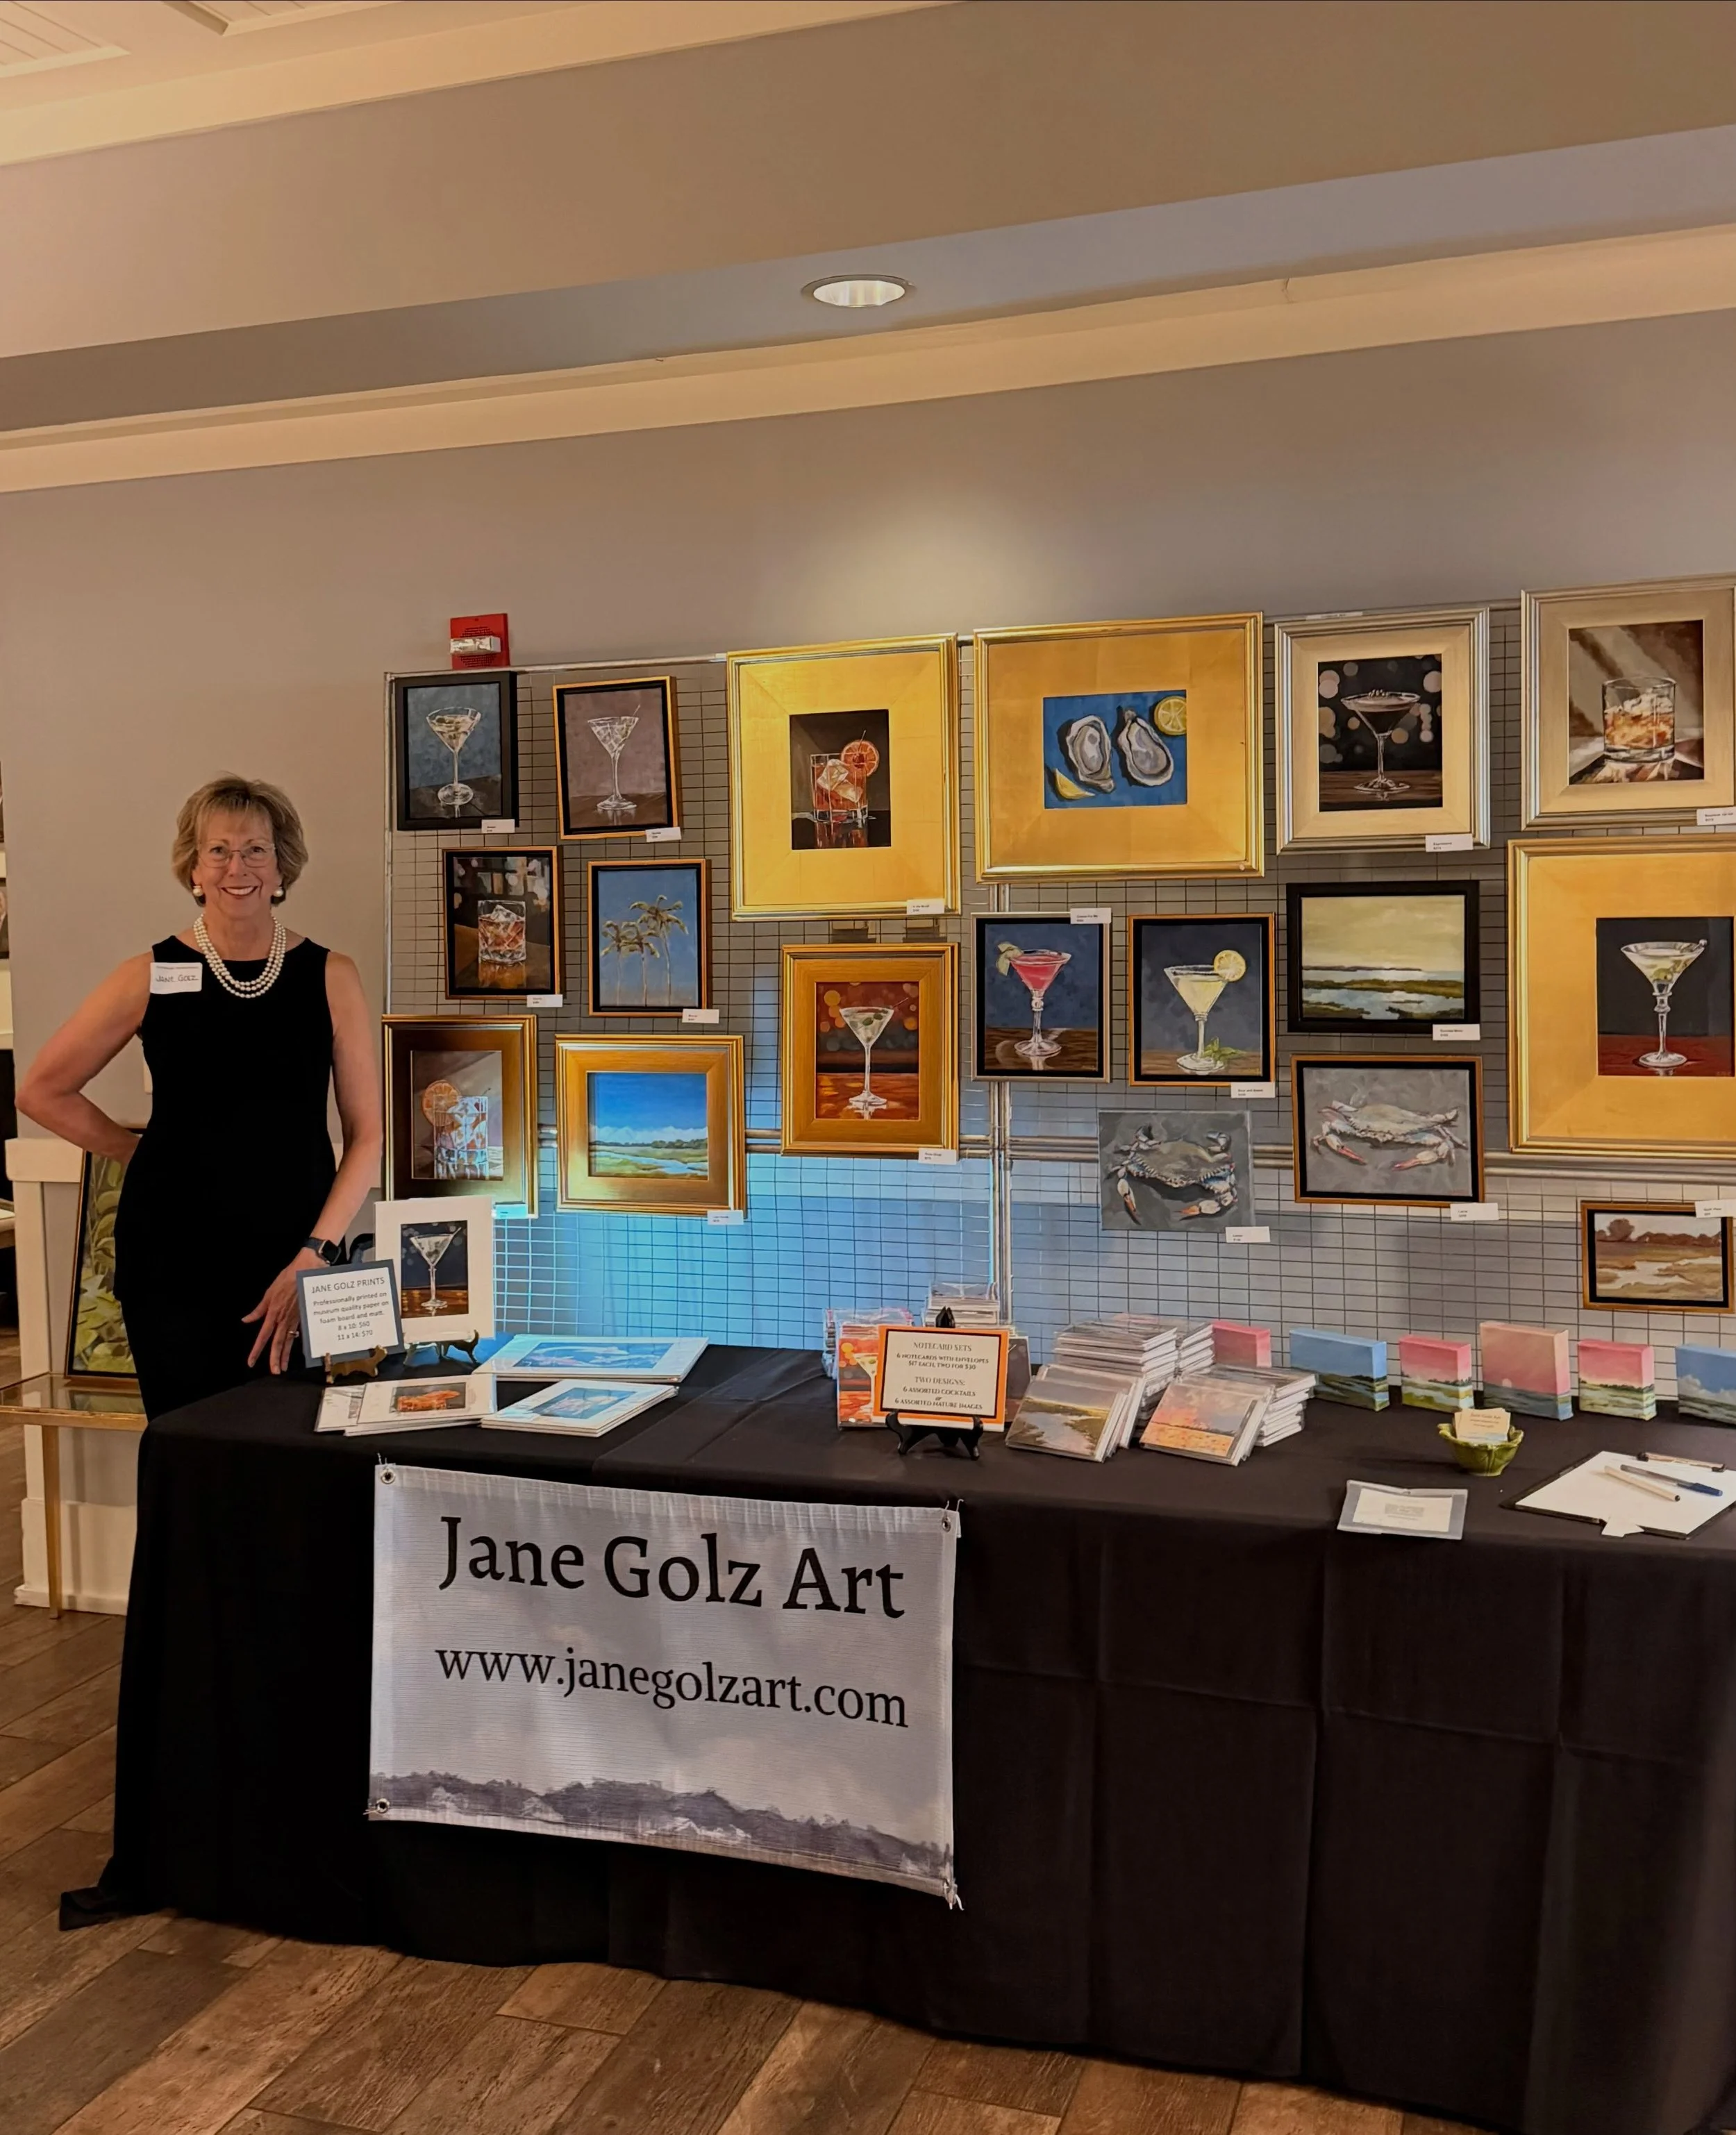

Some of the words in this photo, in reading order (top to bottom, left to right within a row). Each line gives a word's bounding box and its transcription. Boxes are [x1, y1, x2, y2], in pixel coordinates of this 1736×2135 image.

[312, 1284, 331, 1293] JANE
[334, 1281, 355, 1290] GOLZ
[357, 1278, 385, 1287] PRINTS
[313, 1296, 355, 1306] Professionally
[914, 1342, 953, 1350] NOTECARD
[933, 1378, 965, 1386] DESIGNS:
[439, 1516, 585, 1591] Jane
[604, 1532, 762, 1608] Golz
[782, 1548, 905, 1618] Art
[435, 1647, 909, 1728] www.janegolzart.com
